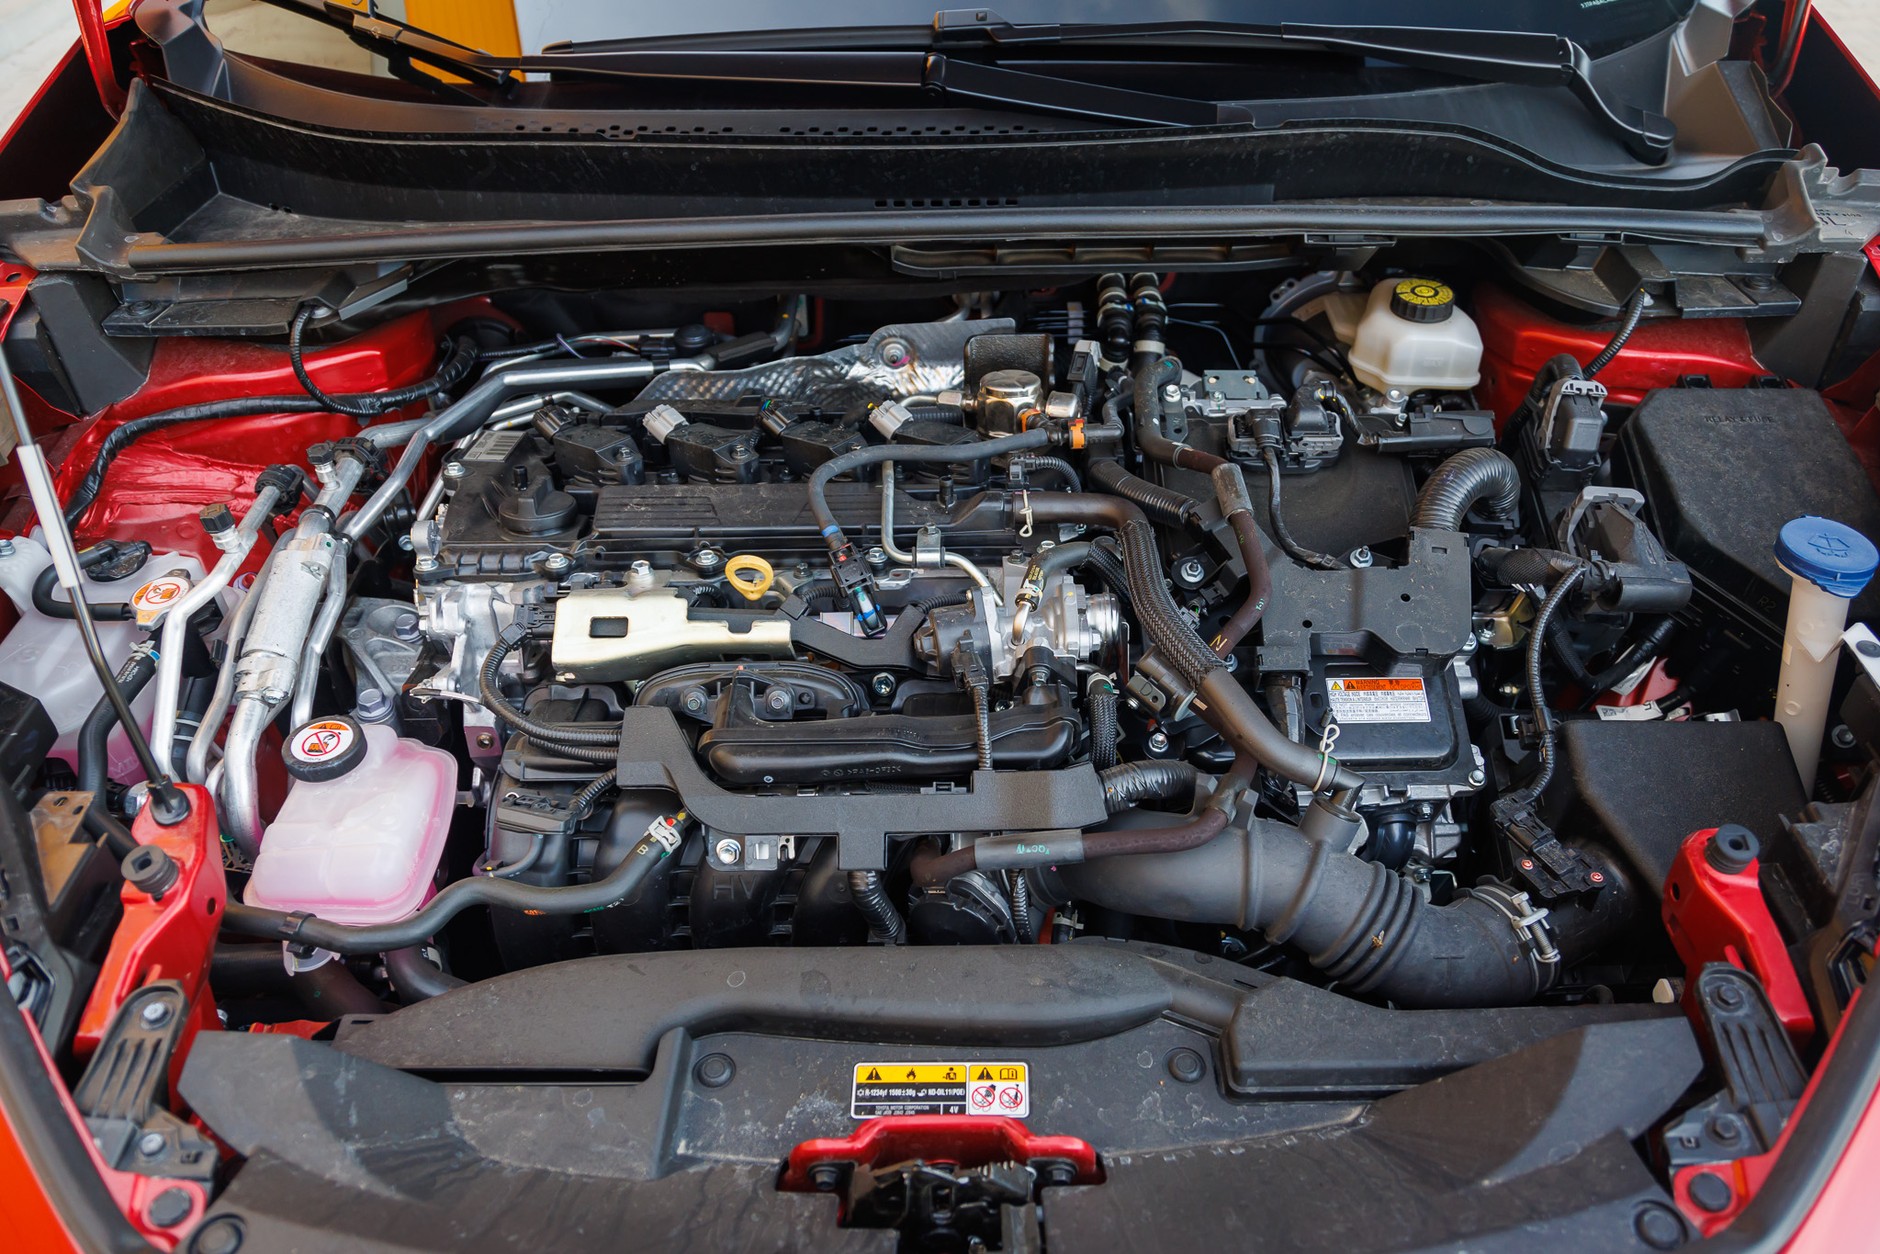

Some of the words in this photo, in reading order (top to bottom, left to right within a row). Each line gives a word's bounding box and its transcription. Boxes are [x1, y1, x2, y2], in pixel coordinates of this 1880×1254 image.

[1704, 415, 1735, 423] RELAY
[637, 844, 649, 856] B
[949, 1106, 959, 1114] 4V
